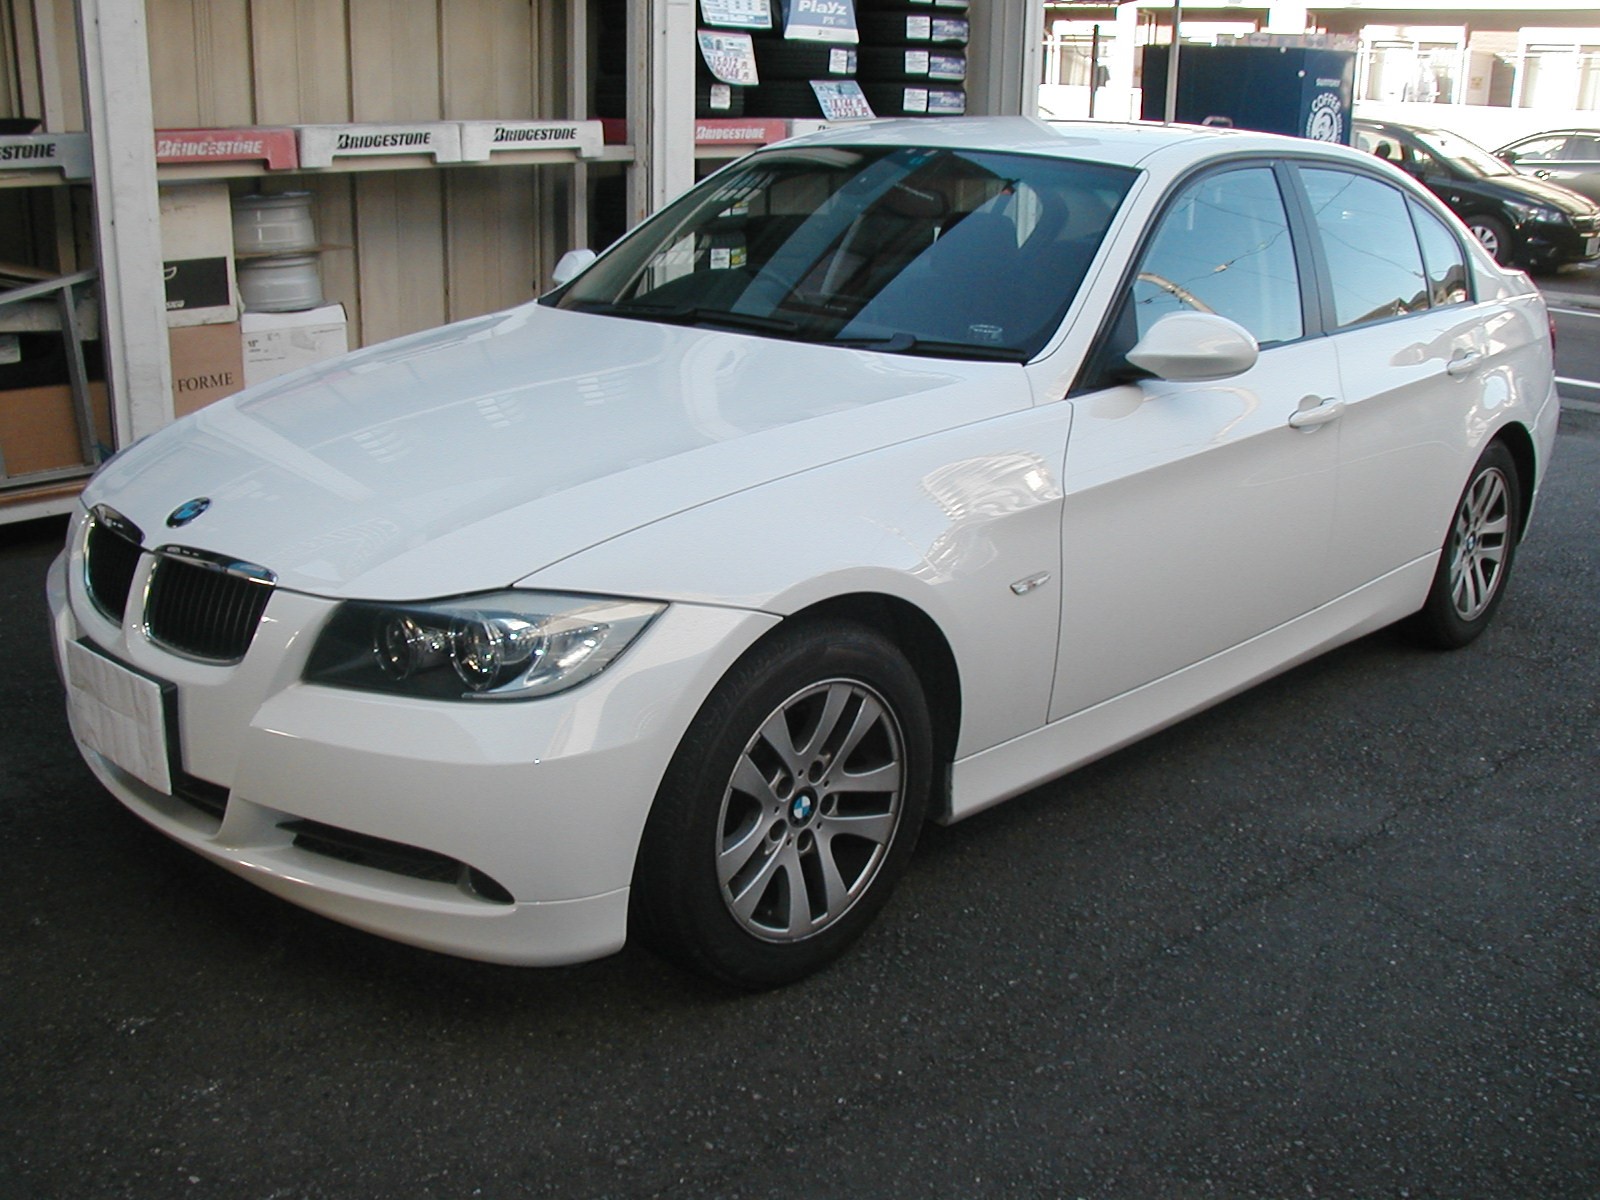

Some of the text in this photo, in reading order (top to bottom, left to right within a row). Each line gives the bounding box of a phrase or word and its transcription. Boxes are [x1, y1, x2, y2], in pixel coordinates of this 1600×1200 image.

[1312, 92, 1341, 113] COFFEE
[337, 132, 431, 150] BRIDGESTONE
[493, 127, 577, 143] BRIDGESTONE
[696, 127, 766, 140] BRIDGESTONE
[156, 139, 263, 157] BRIDGESTONE
[177, 372, 234, 392] FORME
